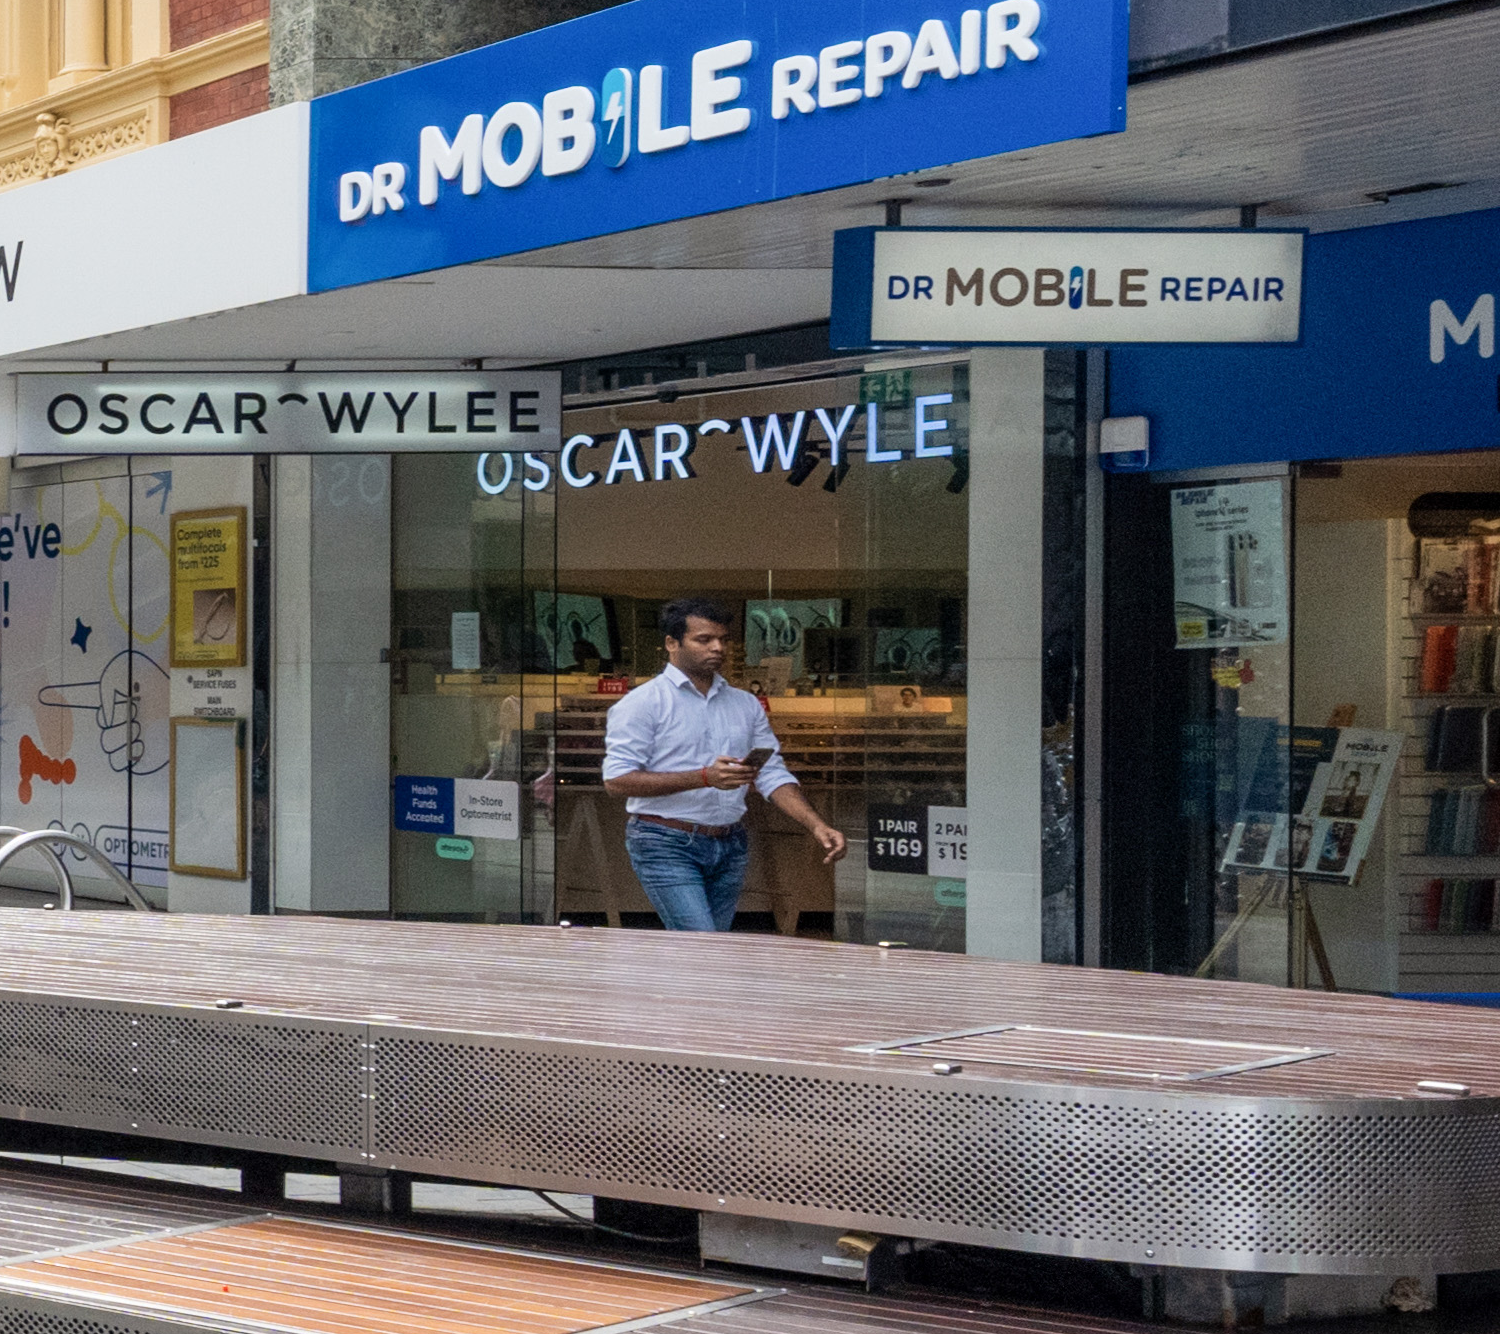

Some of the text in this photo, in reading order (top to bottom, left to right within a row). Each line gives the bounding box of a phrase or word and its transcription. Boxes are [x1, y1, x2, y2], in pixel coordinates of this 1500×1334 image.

[339, 161, 405, 222] DR
[419, 39, 753, 207] MOBILE
[887, 265, 1284, 309] DR MOBILE REPAIR
[47, 391, 541, 435] OSCAR WYLEE
[476, 393, 954, 494] OSCAR WYLE
[177, 528, 222, 542] Complete
[177, 543, 227, 556] multifocals
[193, 679, 217, 689] SERVICE
[207, 697, 222, 705] MAIN
[193, 707, 237, 717] SWITCHBOARD
[411, 784, 438, 796] Health
[412, 798, 437, 810] Funds
[468, 794, 504, 807] In-Store
[405, 812, 445, 824] Accepted
[460, 808, 513, 822] Optometrist
[886, 820, 917, 833] PAIR
[935, 823, 967, 837] 2 PAI
